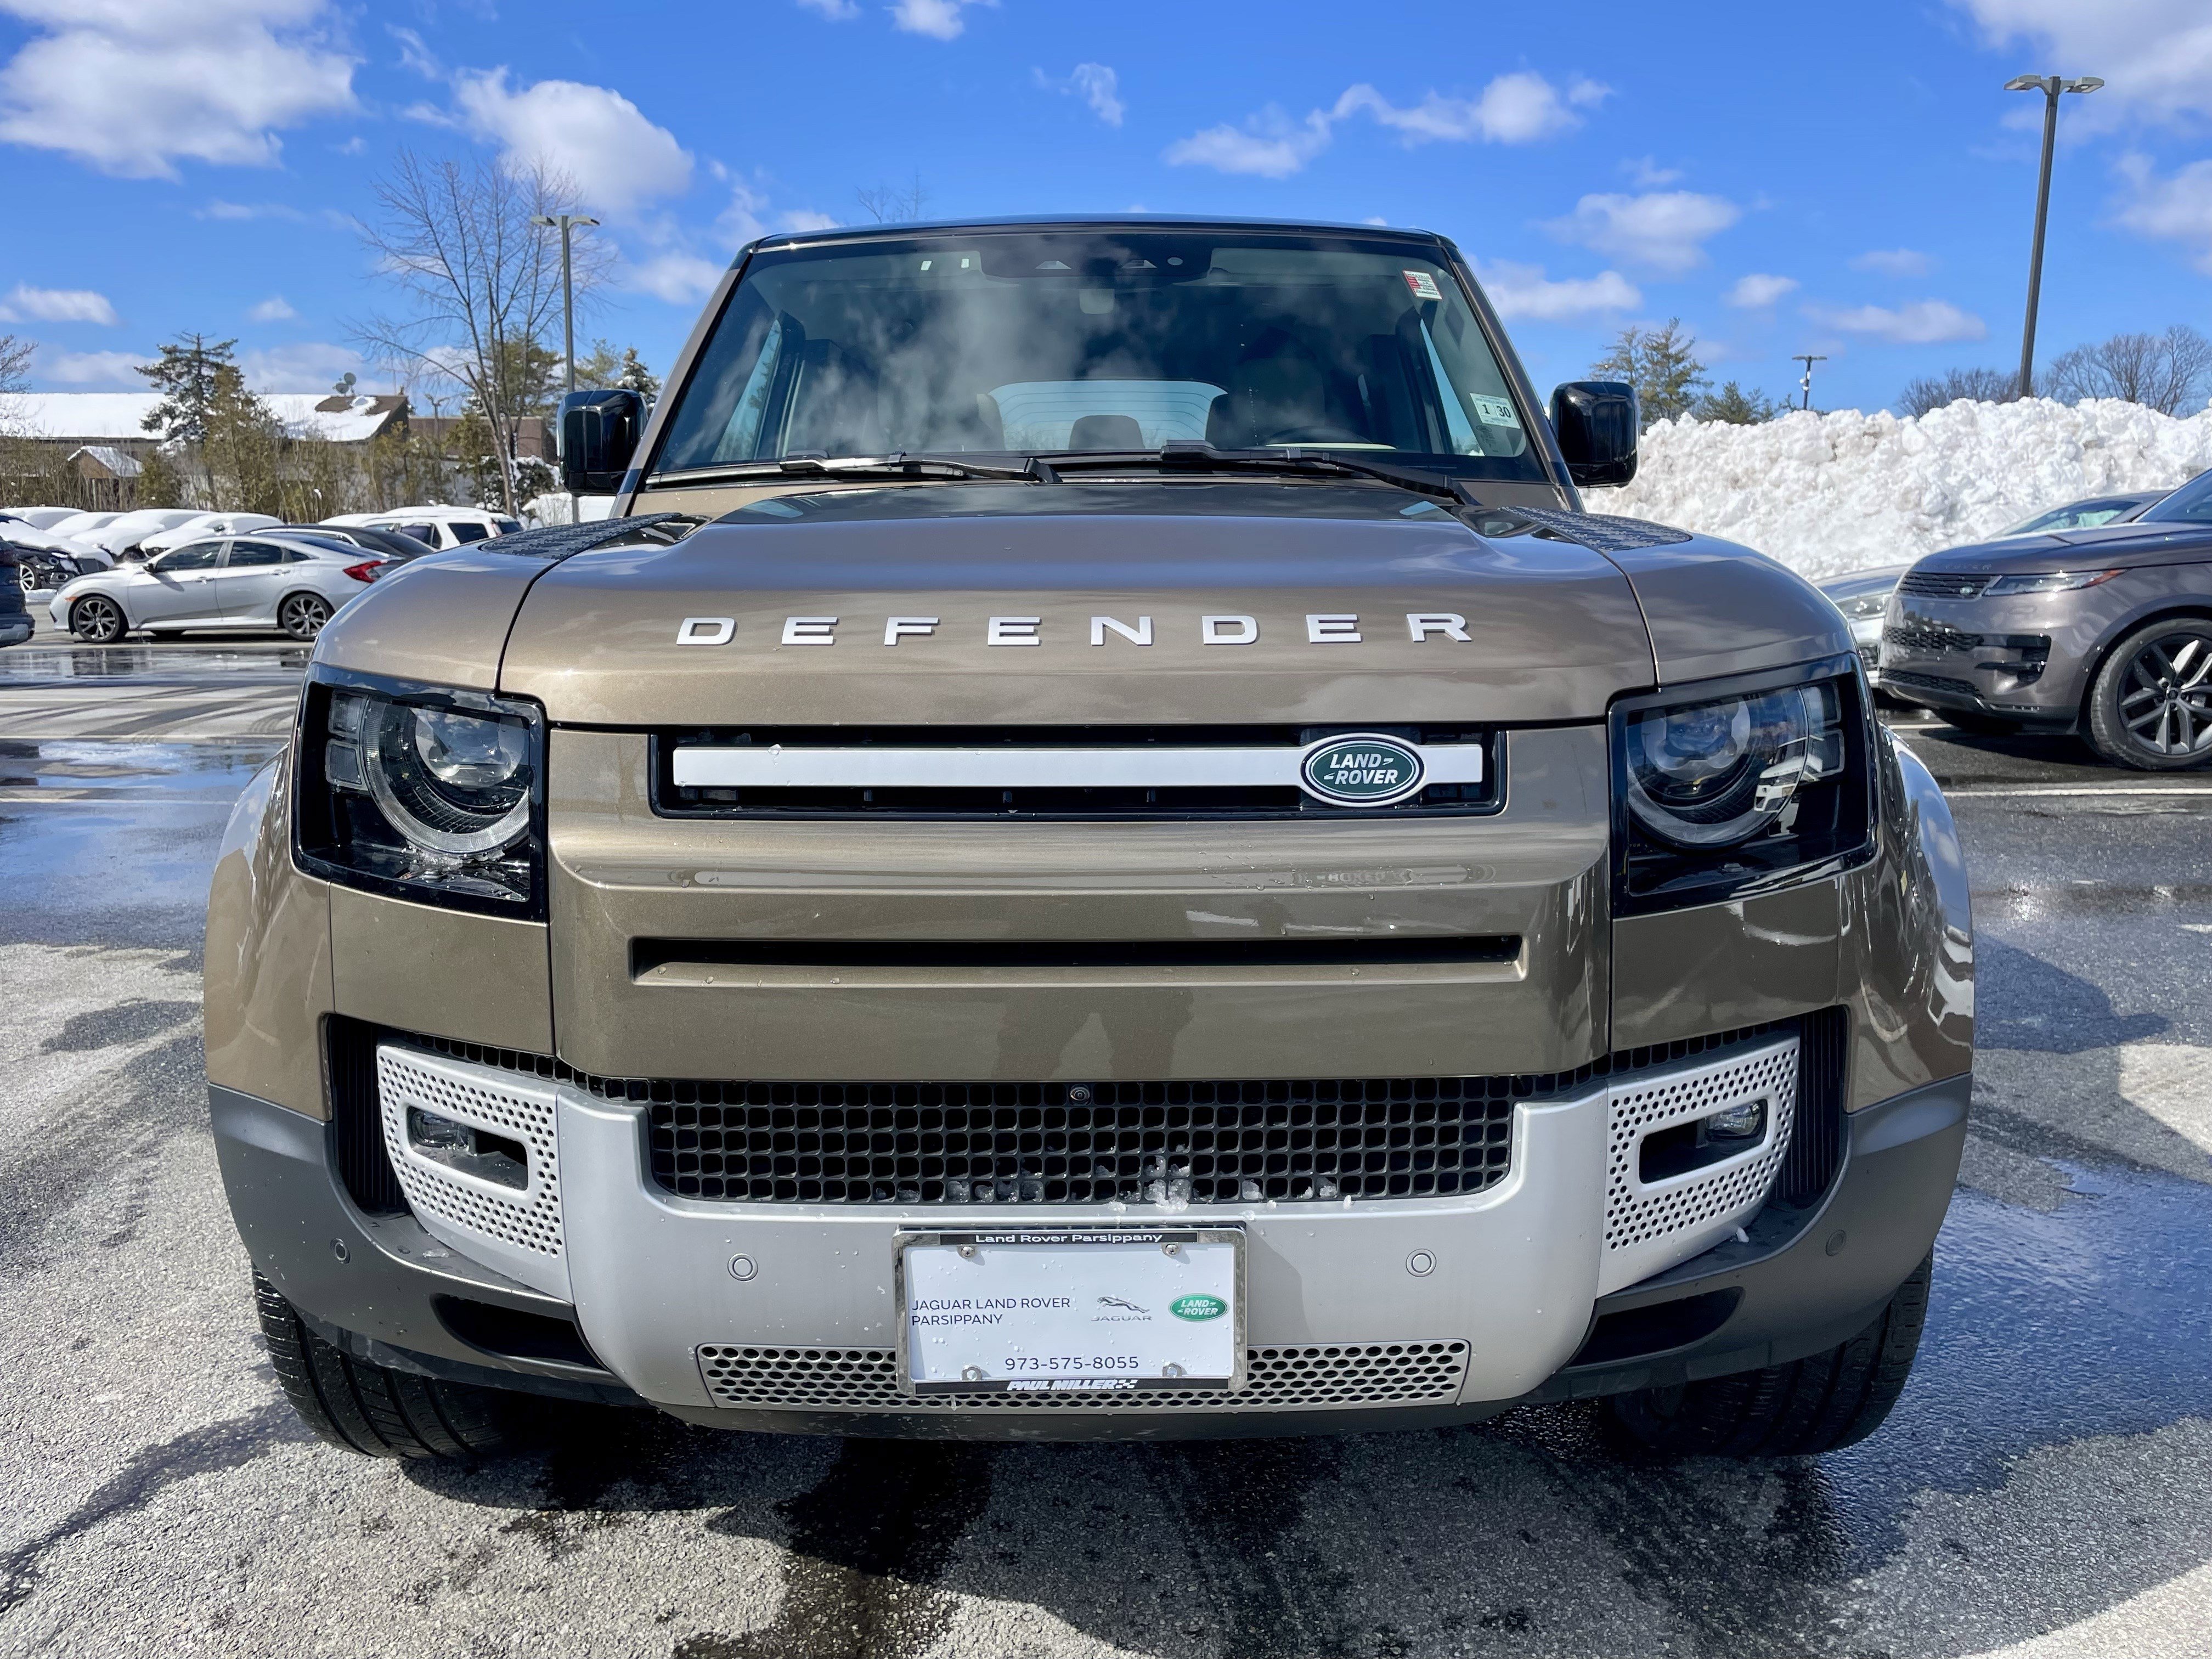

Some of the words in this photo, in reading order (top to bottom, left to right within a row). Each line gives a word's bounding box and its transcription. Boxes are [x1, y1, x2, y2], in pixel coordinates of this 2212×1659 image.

[1482, 404, 1491, 415] 1
[1496, 405, 1511, 418] 30
[676, 612, 1473, 646] DEFENDER
[1330, 753, 1381, 768] LAND
[1335, 769, 1398, 785] ROVER
[975, 1234, 1015, 1243] Land
[1071, 1234, 1163, 1243] Parsippany
[912, 1299, 972, 1310] JAGUAR
[976, 1298, 1017, 1309] LAND
[1021, 1297, 1070, 1308] ROVER
[912, 1314, 1003, 1325] PARSIPPANY
[1005, 1356, 1139, 1370] 973-575-8055
[1006, 1380, 1050, 1391] PAUL
[1050, 1379, 1118, 1390] MILLER
